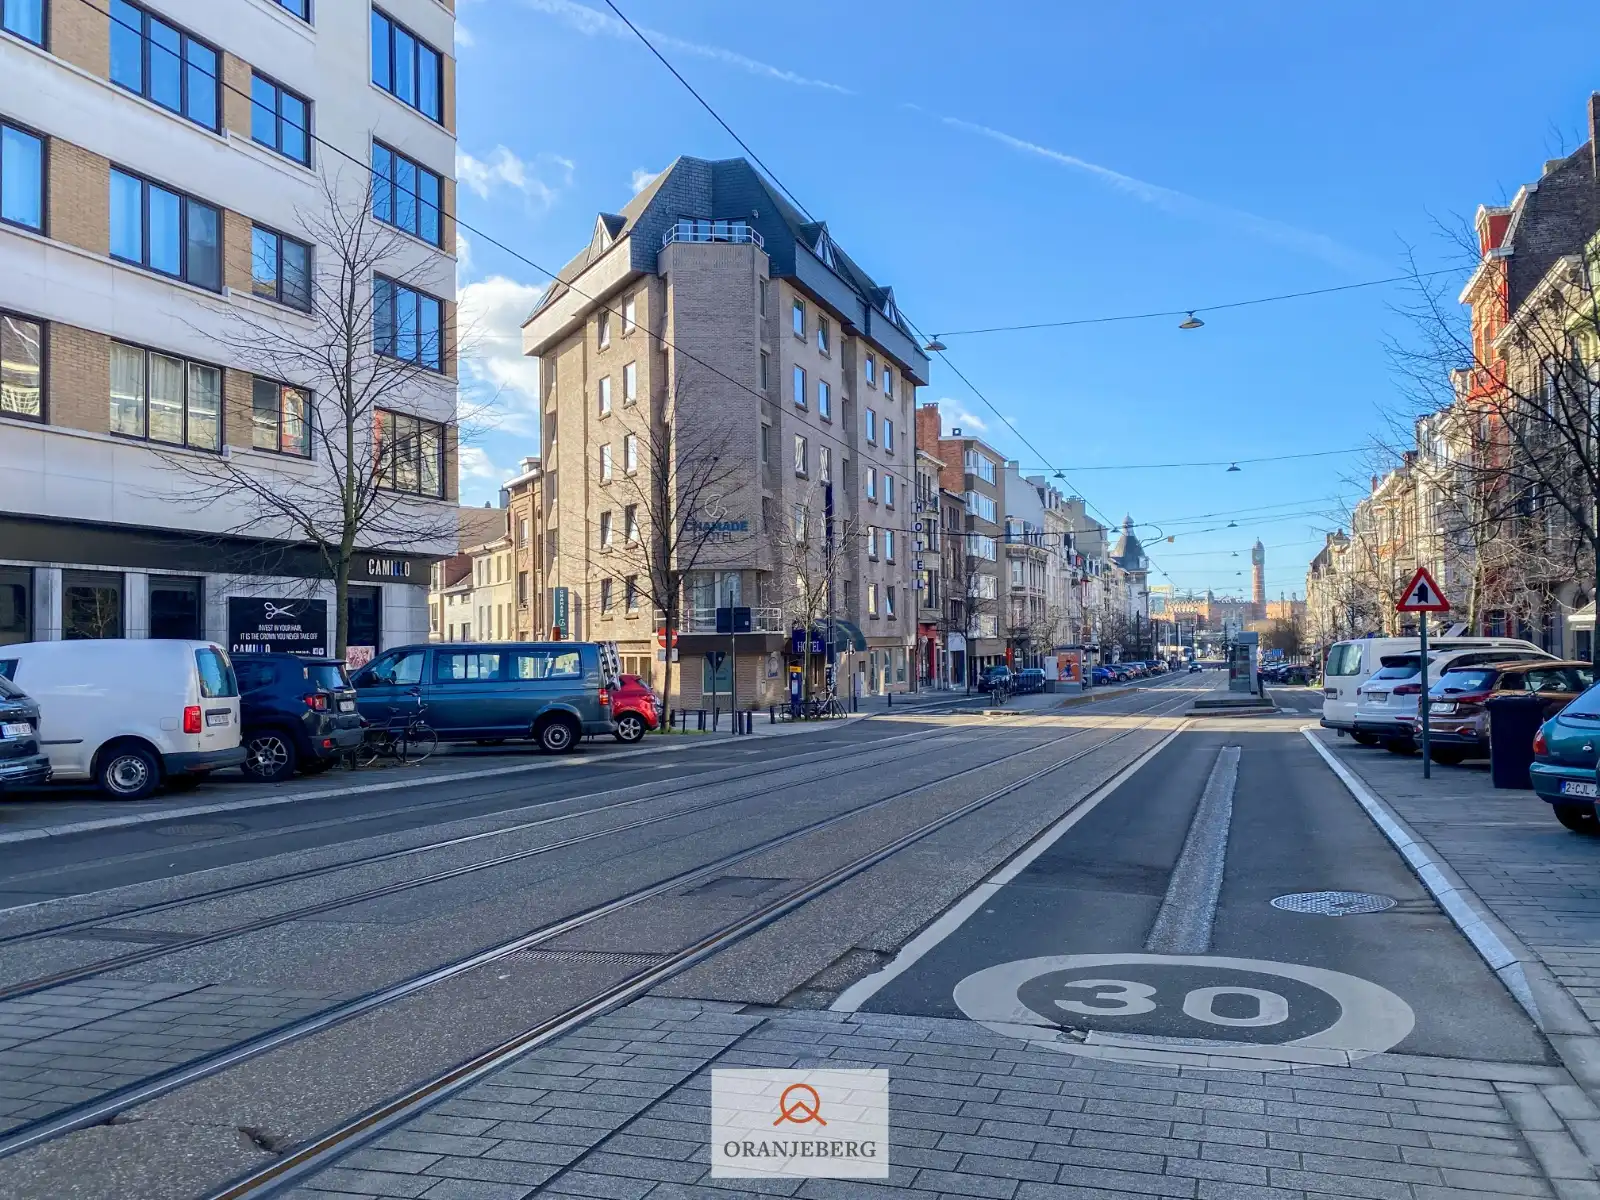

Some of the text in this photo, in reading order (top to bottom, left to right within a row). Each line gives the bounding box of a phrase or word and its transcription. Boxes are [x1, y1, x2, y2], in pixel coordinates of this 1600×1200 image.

[368, 558, 410, 577] CAMILLO
[279, 624, 291, 632] YOUR
[251, 632, 260, 640] THE
[277, 632, 286, 640] YOU
[1054, 979, 1289, 1027] 30
